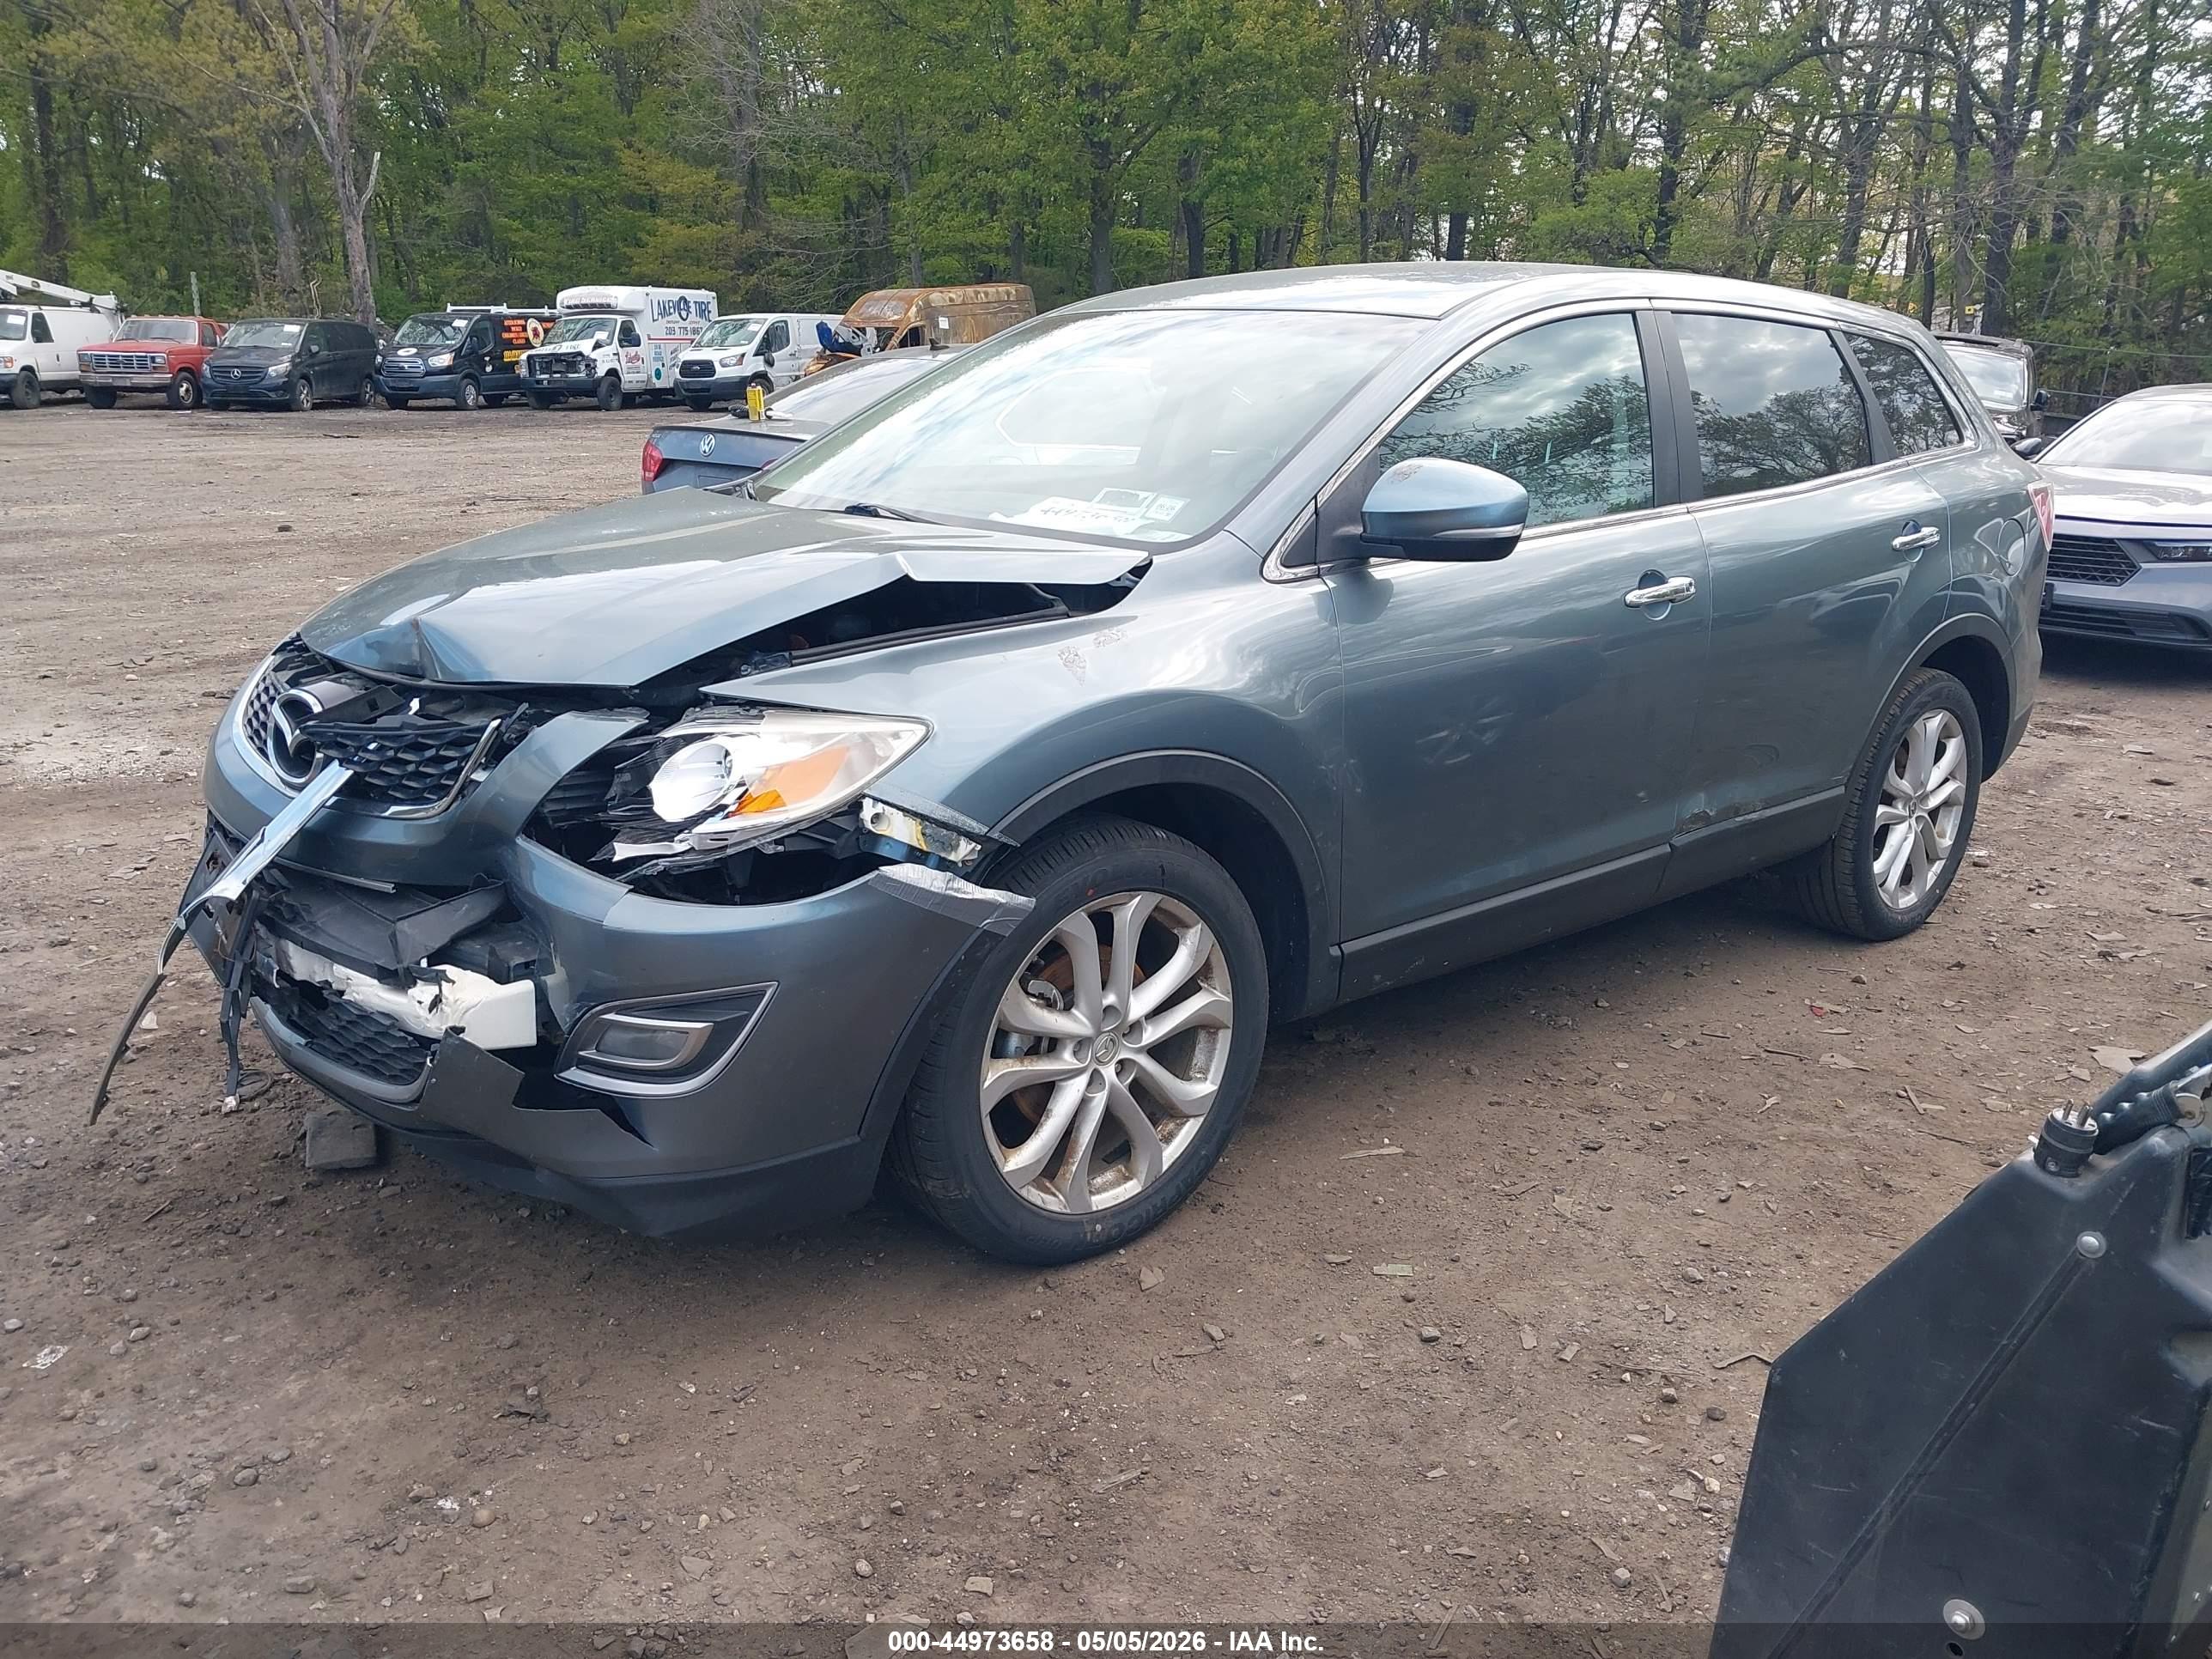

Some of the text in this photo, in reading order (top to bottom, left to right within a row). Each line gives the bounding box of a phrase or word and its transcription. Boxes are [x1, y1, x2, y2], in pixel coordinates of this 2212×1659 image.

[650, 298, 713, 323] LAKEVILLE TIRE
[665, 326, 676, 336] 203
[678, 326, 689, 336] 775
